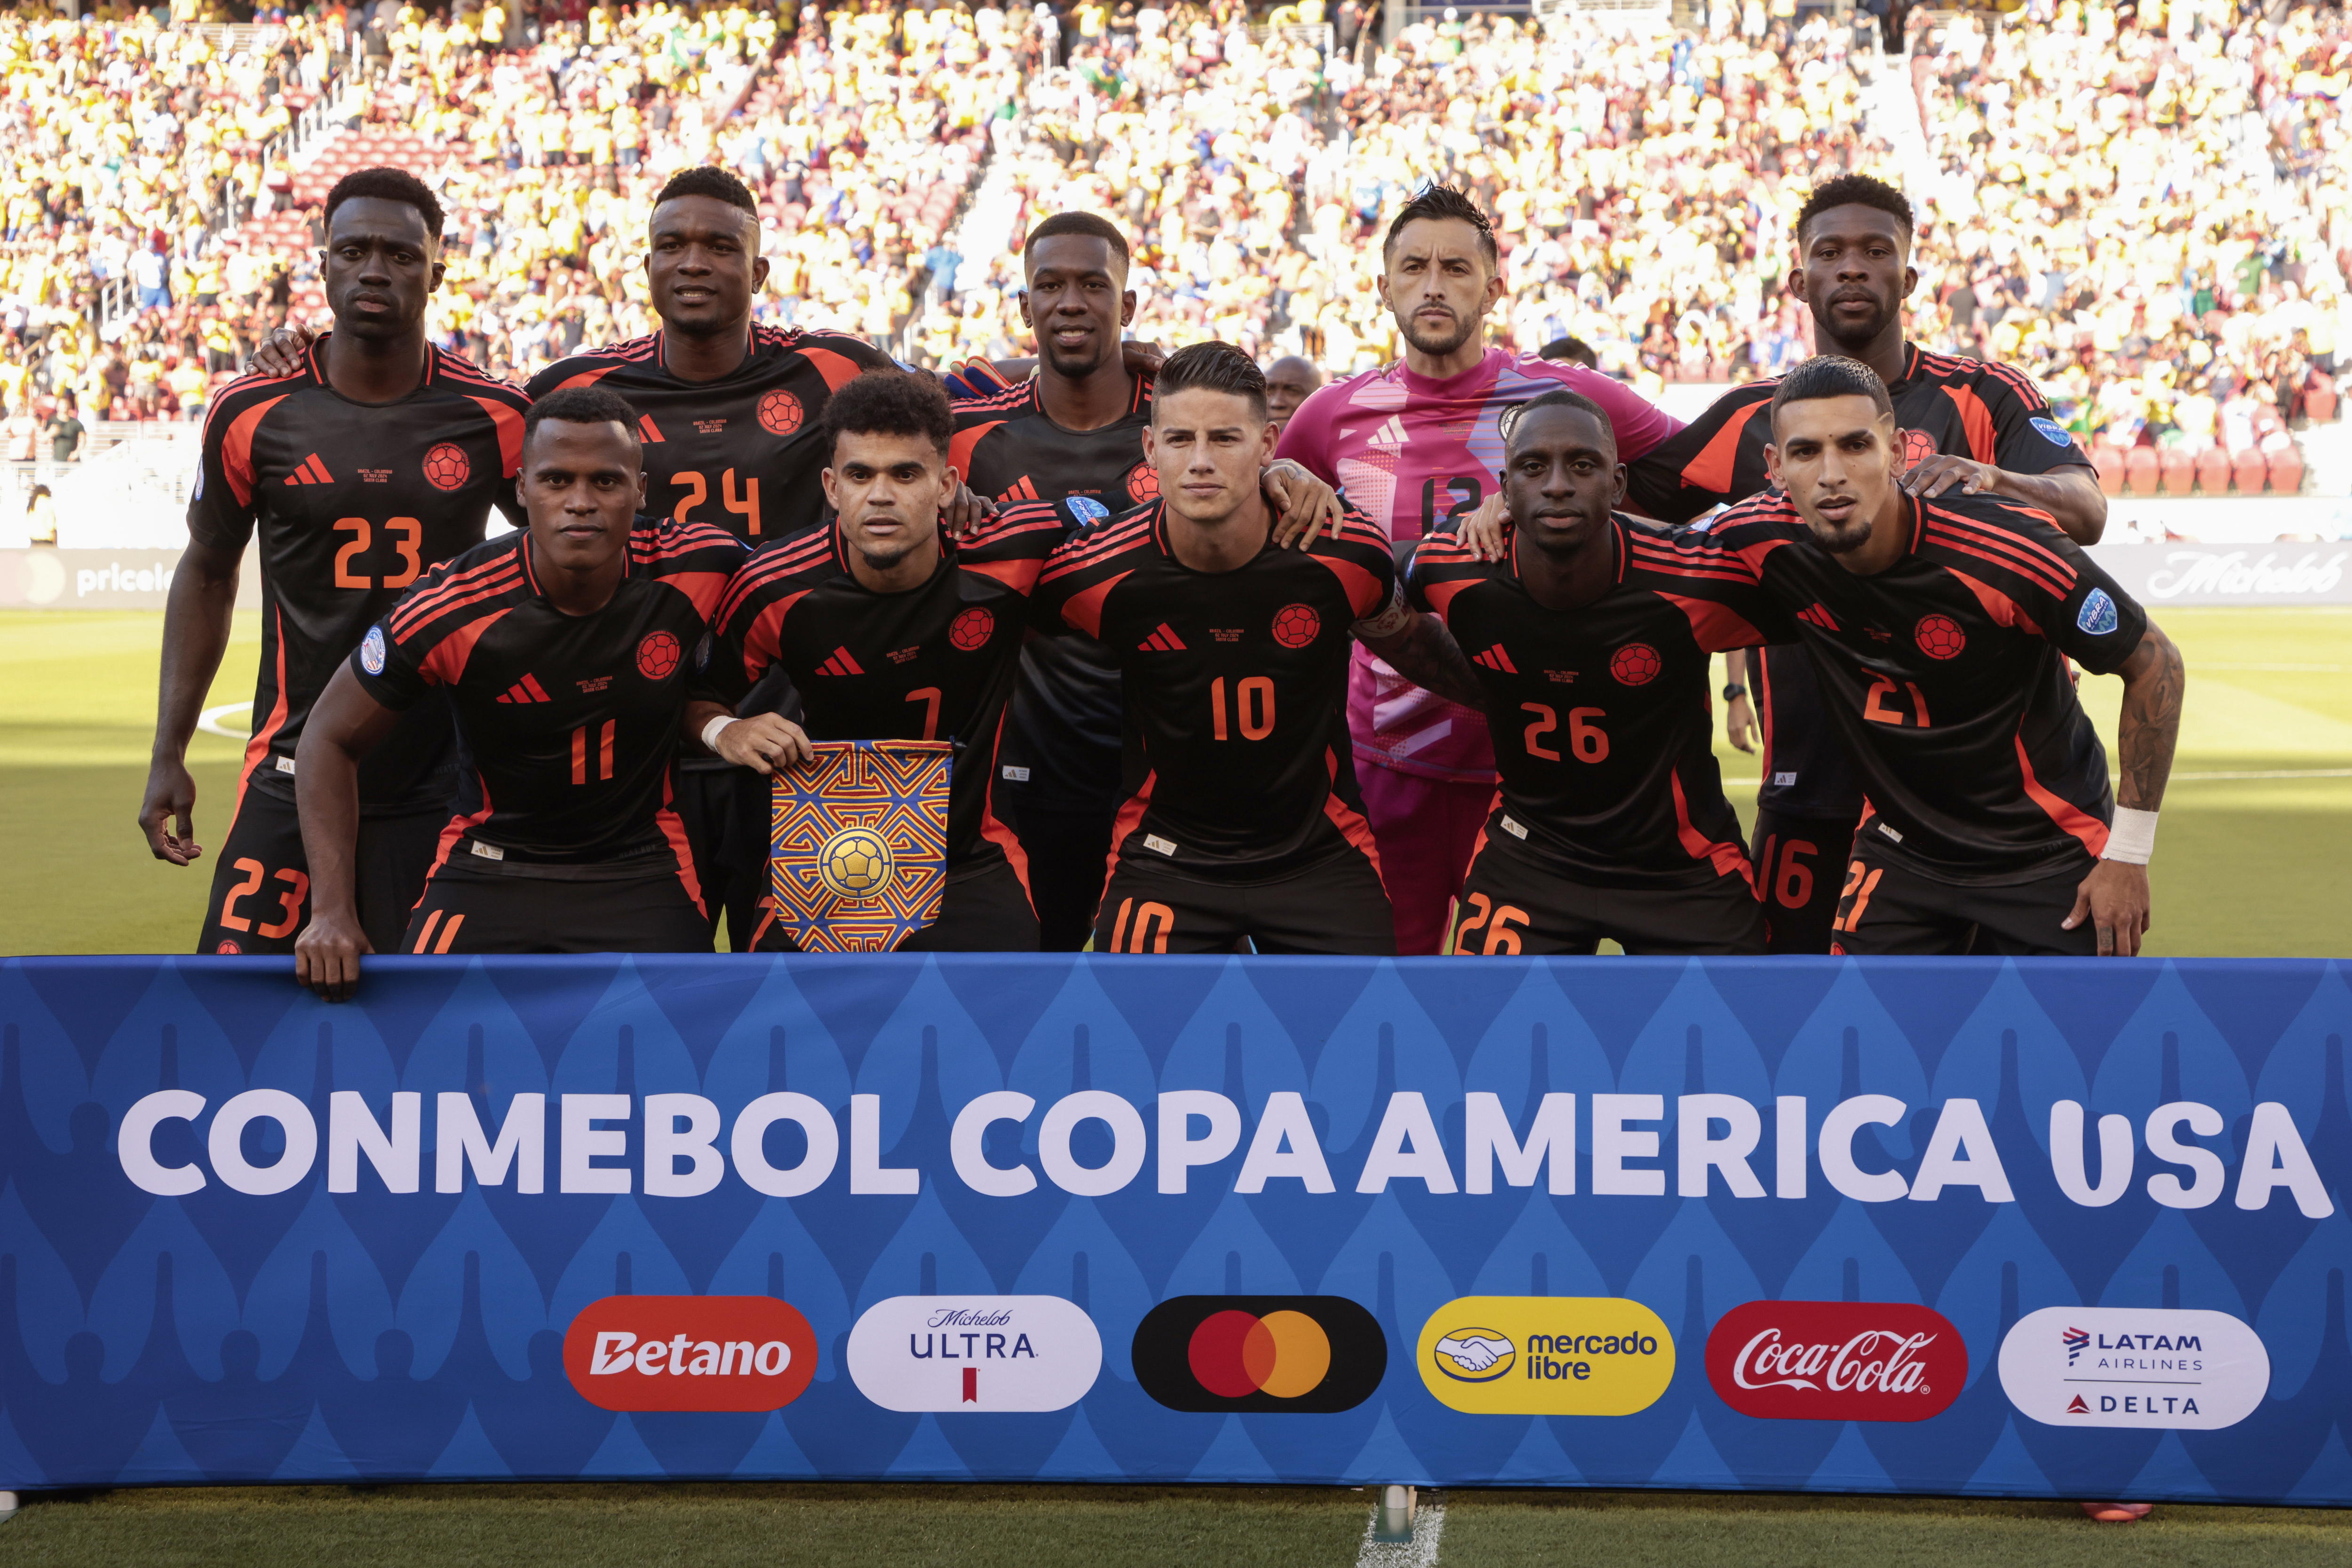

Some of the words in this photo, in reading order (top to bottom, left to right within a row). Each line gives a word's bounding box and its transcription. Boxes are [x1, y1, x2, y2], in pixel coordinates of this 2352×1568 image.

[670, 468, 761, 535] 24
[333, 517, 422, 589] 23
[2146, 551, 2348, 599] Michelob
[2086, 596, 2106, 628] VIBRA
[906, 687, 941, 740] 7
[1211, 677, 1275, 741] 10
[1861, 667, 1930, 727] 21
[572, 718, 615, 785] 11
[1521, 702, 1609, 764] 26
[434, 763, 460, 775] HEAT.R
[1758, 833, 1818, 909] 16
[220, 857, 309, 939] 23
[1454, 892, 1530, 955] 26
[413, 909, 465, 954] 11
[1110, 897, 1174, 954] 10
[118, 1089, 920, 1197] CONMEBOL
[950, 1090, 1336, 1196] COPA
[1355, 1091, 2015, 1203] AMERICA
[2050, 1099, 2334, 1218] USA
[927, 1309, 1013, 1328] Michelob
[1528, 1330, 1657, 1355] mercado
[2098, 1334, 2202, 1352] LATAM
[590, 1331, 791, 1376] Betano
[910, 1333, 1036, 1359] ULTRA
[1528, 1355, 1590, 1380] libre
[1733, 1328, 1938, 1393] Coca-Cola
[2098, 1358, 2203, 1370] AIRLINES
[2101, 1395, 2200, 1415] DELTA
